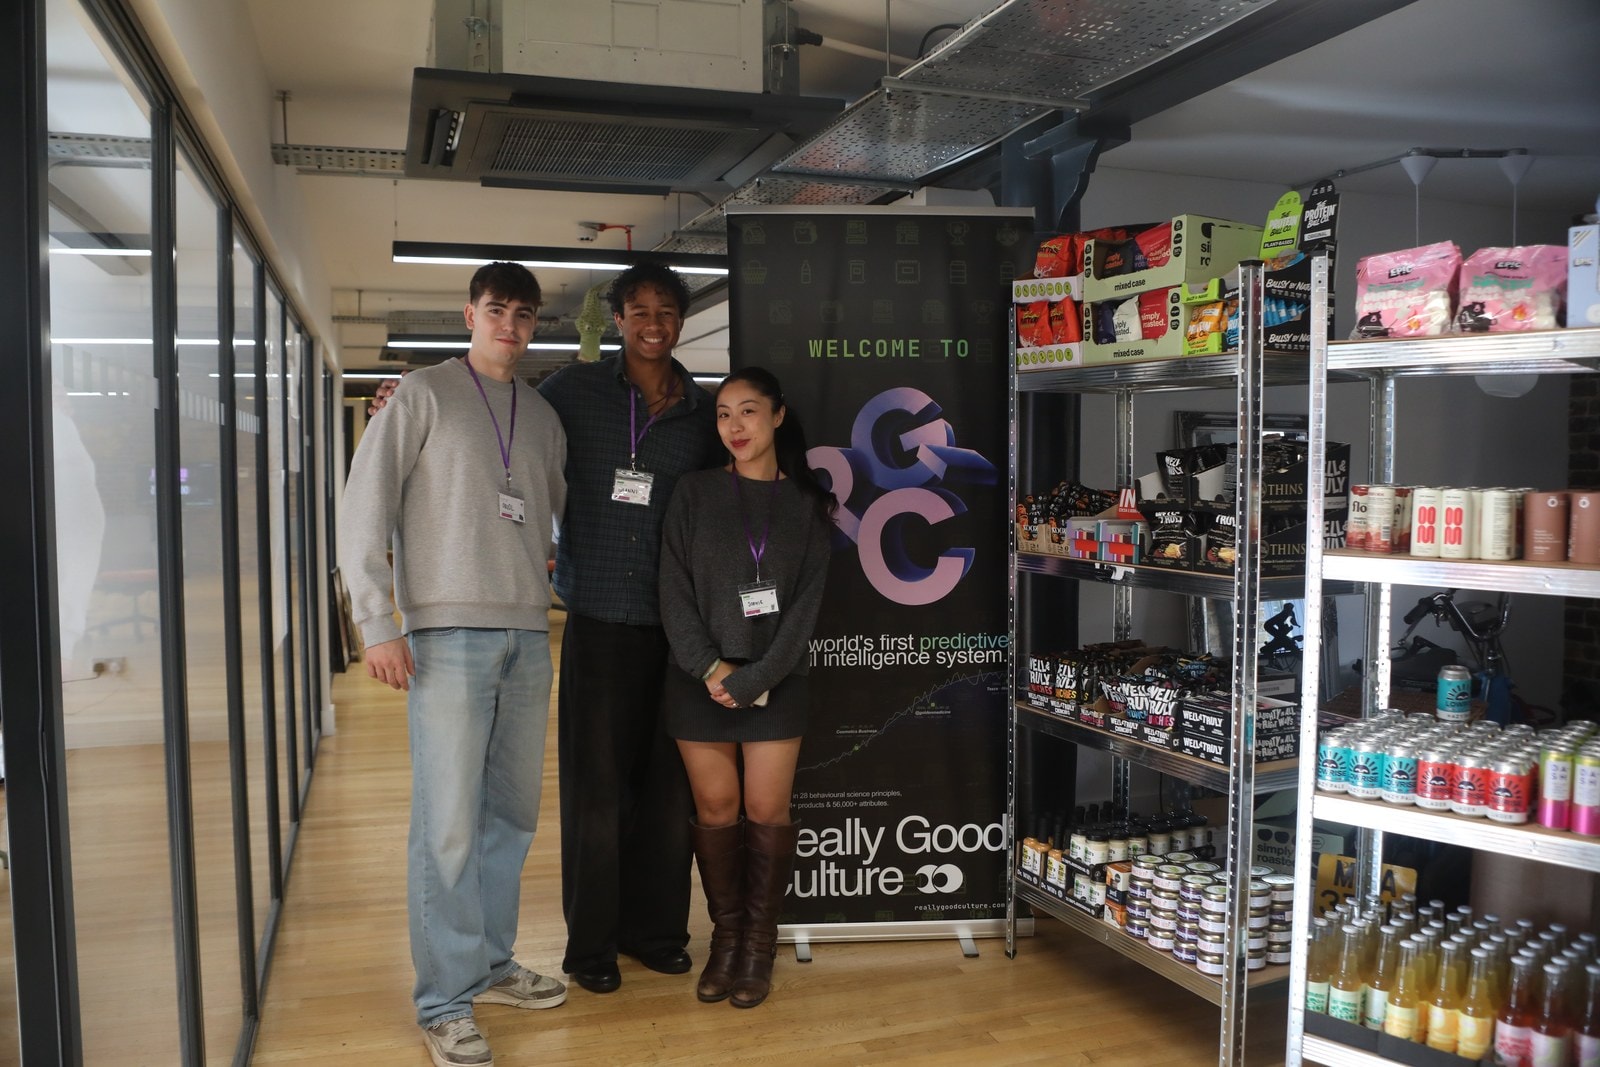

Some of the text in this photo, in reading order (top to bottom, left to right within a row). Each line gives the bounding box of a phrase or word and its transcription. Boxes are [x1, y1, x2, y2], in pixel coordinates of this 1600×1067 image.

[1304, 204, 1336, 222] PROTEIN
[1269, 215, 1298, 230] PROTEIN
[1114, 278, 1146, 292] mixed case
[1266, 278, 1291, 289] BALLSY
[1268, 333, 1294, 344] BALLSY
[808, 338, 970, 358] WELCOME TO
[1113, 347, 1145, 359] mixed case
[1268, 483, 1304, 496] THINS
[1270, 543, 1306, 556] THINS
[808, 632, 1009, 654] world's first predictive
[824, 649, 930, 670] intelligence
[935, 648, 1007, 668] system.
[809, 791, 846, 799] behavioural
[871, 789, 903, 798] principles.
[798, 801, 825, 810] products
[832, 800, 858, 808] 56,000+
[859, 799, 889, 807] attributes.
[796, 813, 1008, 865] eally Good
[1257, 843, 1293, 859] simply
[1257, 855, 1292, 867] roaste
[785, 860, 904, 898] ulture
[914, 903, 1006, 911] reallygoodculture.com
